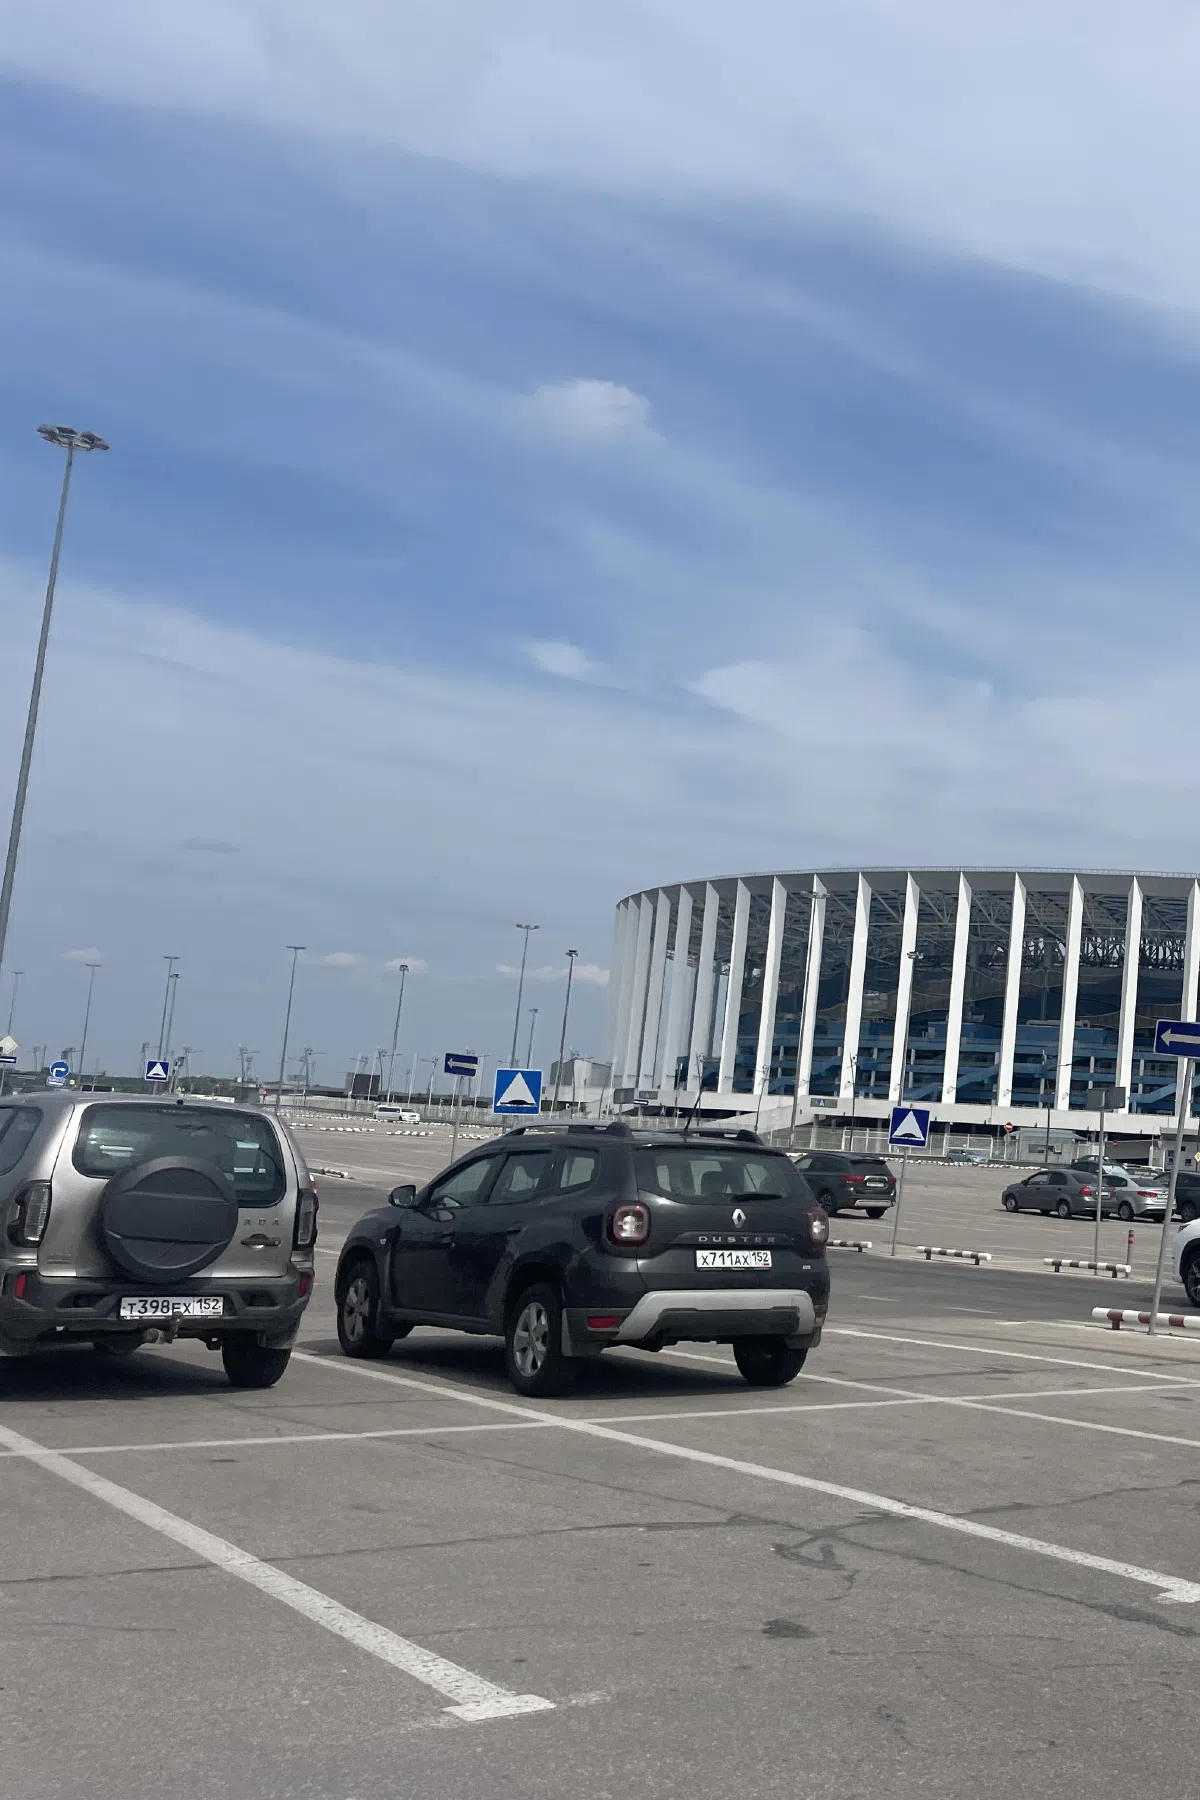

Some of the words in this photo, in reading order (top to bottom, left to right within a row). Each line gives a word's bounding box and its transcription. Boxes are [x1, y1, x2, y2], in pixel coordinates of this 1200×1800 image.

[698, 1236, 776, 1244] DUSTER
[751, 1252, 769, 1263] 152
[196, 1298, 219, 1310] 152
